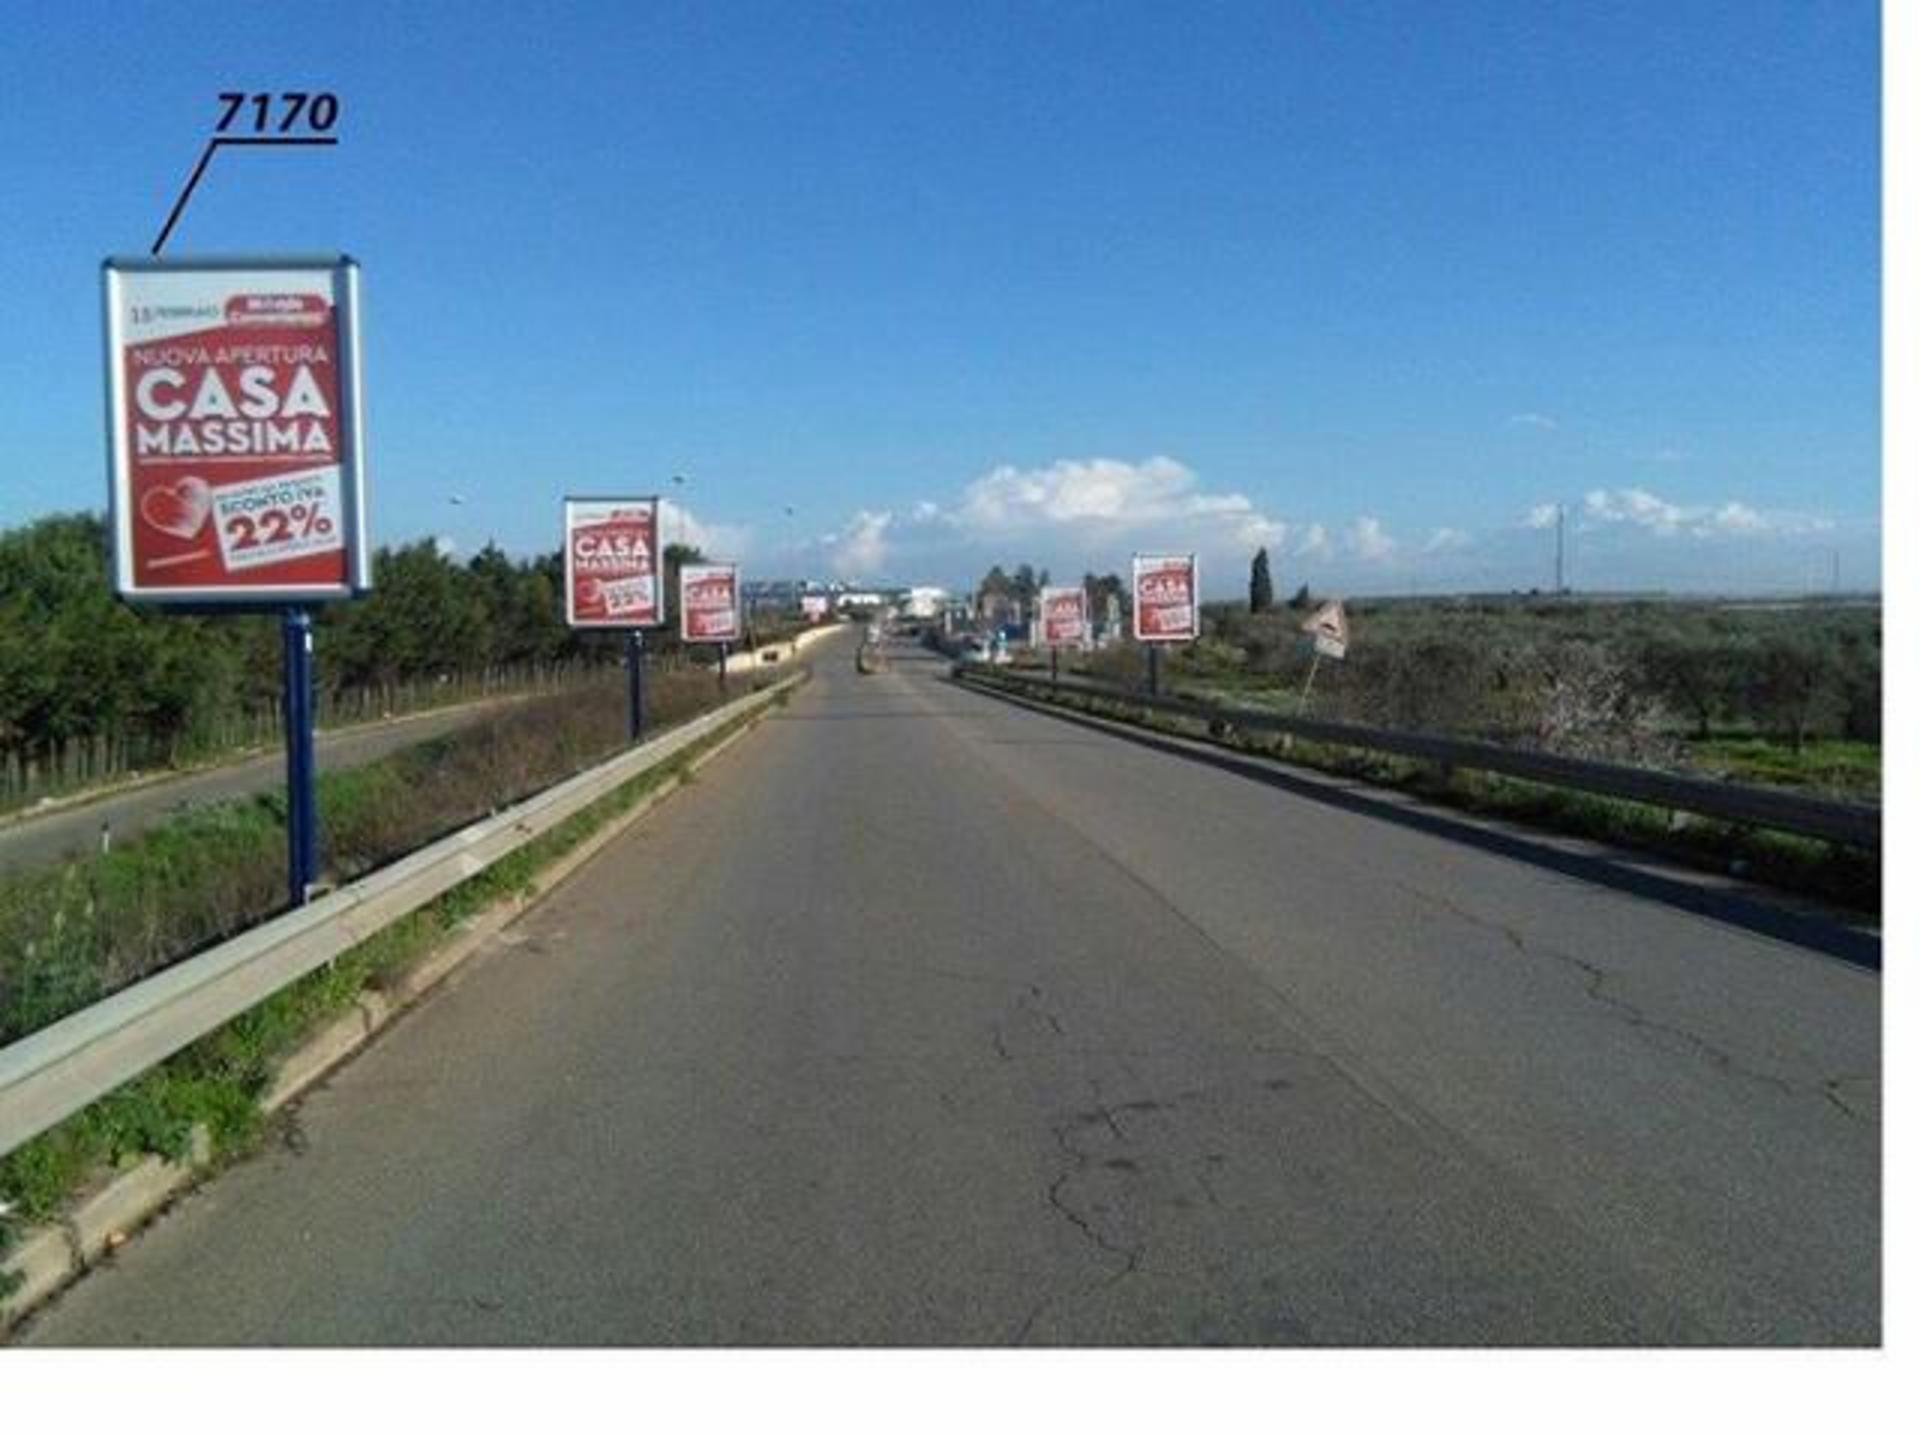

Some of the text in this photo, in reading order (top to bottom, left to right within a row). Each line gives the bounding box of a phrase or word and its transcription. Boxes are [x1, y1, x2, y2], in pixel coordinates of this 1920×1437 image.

[134, 343, 328, 366] NUOVA APERTURA
[136, 365, 331, 420] CASA
[136, 421, 332, 454] MASSIMA
[226, 501, 333, 552] 22%
[575, 535, 650, 558] CASA
